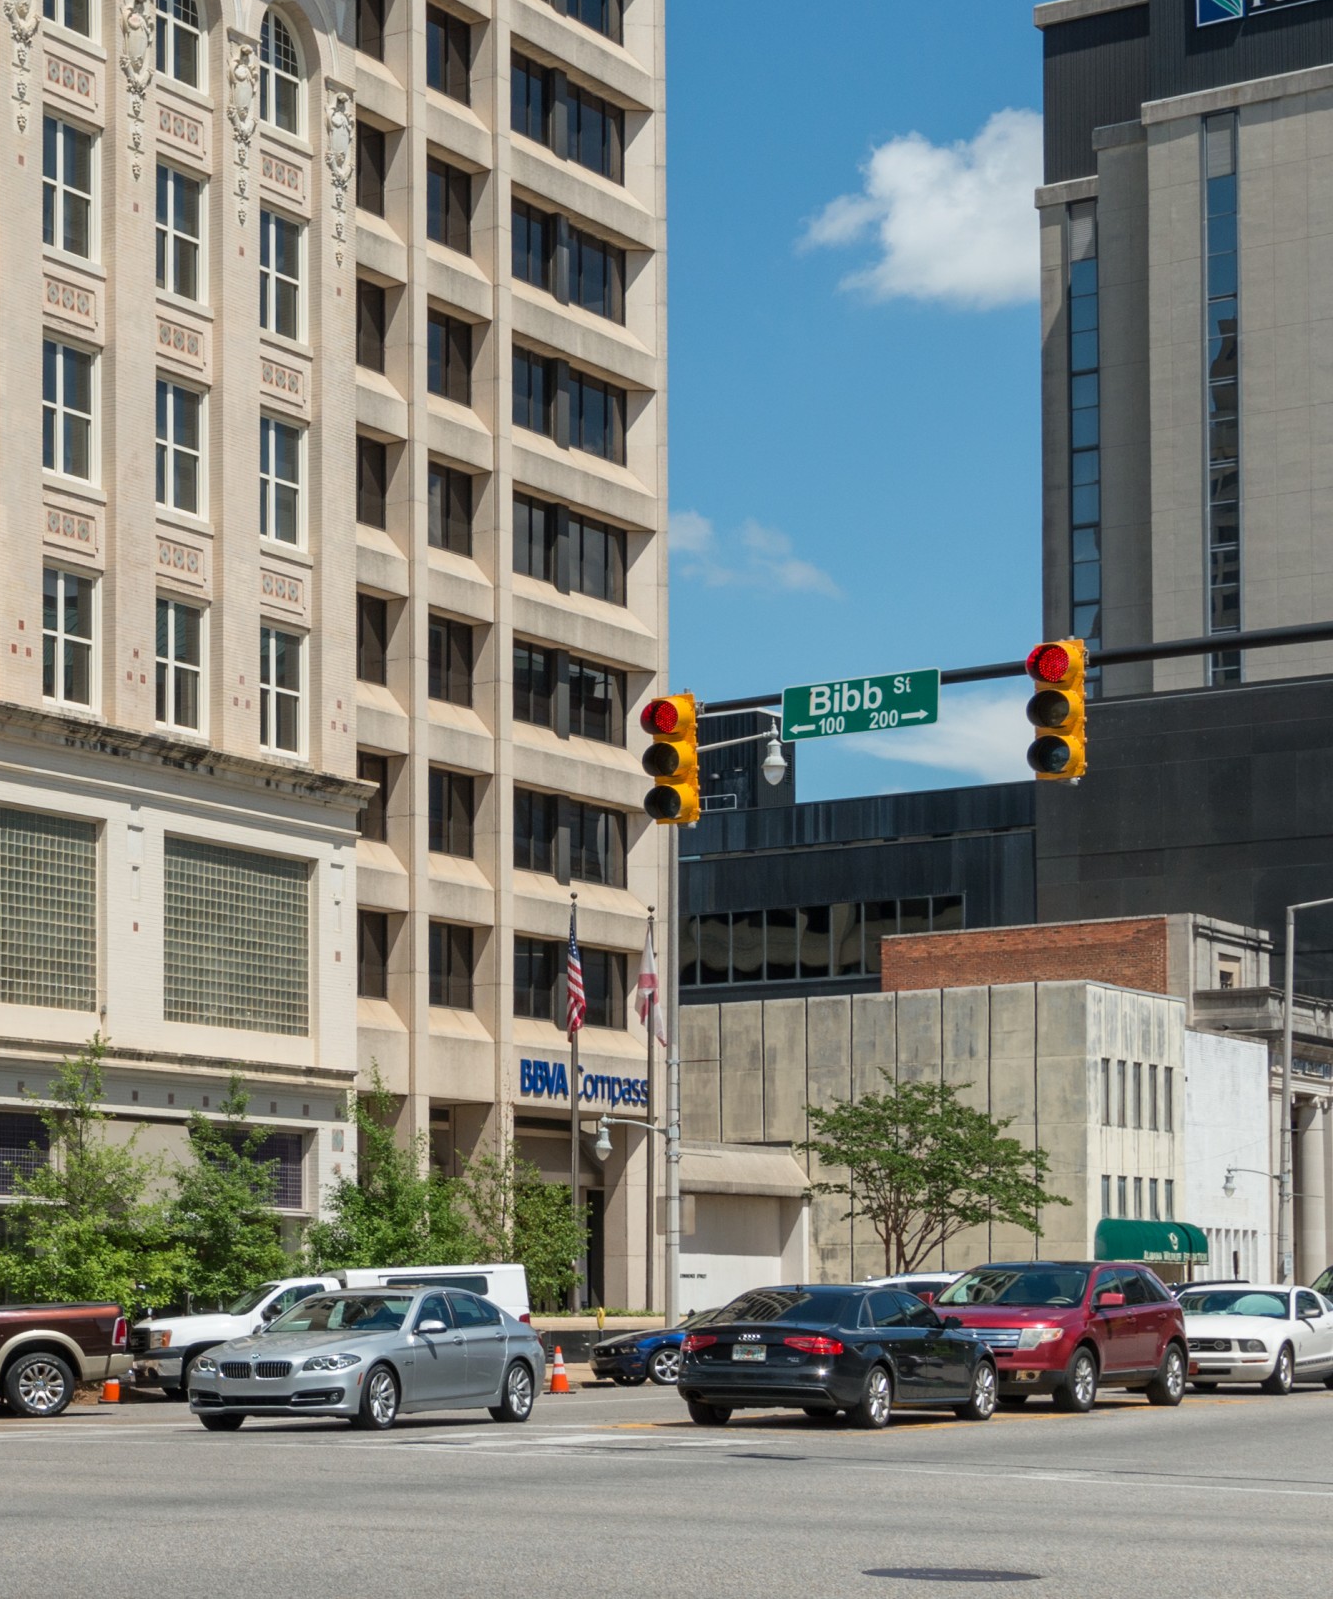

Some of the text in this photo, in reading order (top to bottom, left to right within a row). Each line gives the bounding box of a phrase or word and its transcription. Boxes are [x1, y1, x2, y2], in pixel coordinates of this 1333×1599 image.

[809, 676, 912, 717] Bibb St
[819, 709, 899, 735] 100 200
[520, 1058, 569, 1097] BBVA
